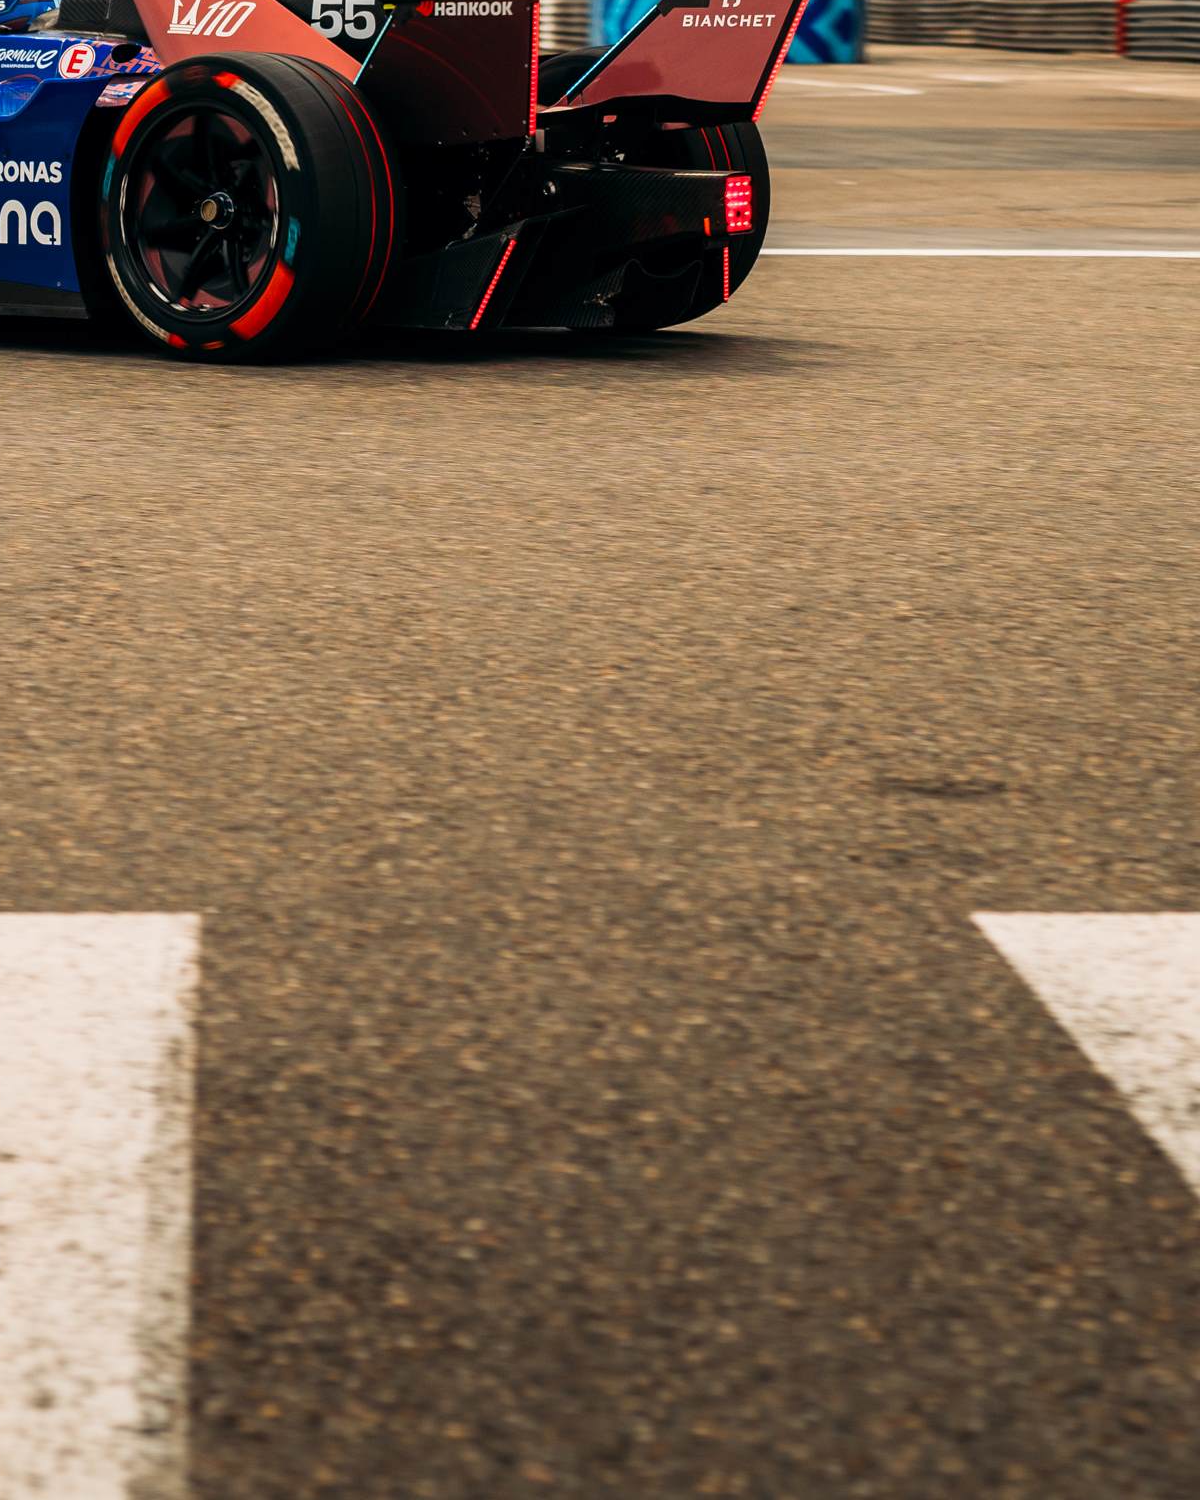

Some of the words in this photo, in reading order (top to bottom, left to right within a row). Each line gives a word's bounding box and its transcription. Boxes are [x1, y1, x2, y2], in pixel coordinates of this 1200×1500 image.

[192, 0, 257, 37] 110
[682, 14, 776, 27] BIANCHET
[66, 49, 88, 74] E
